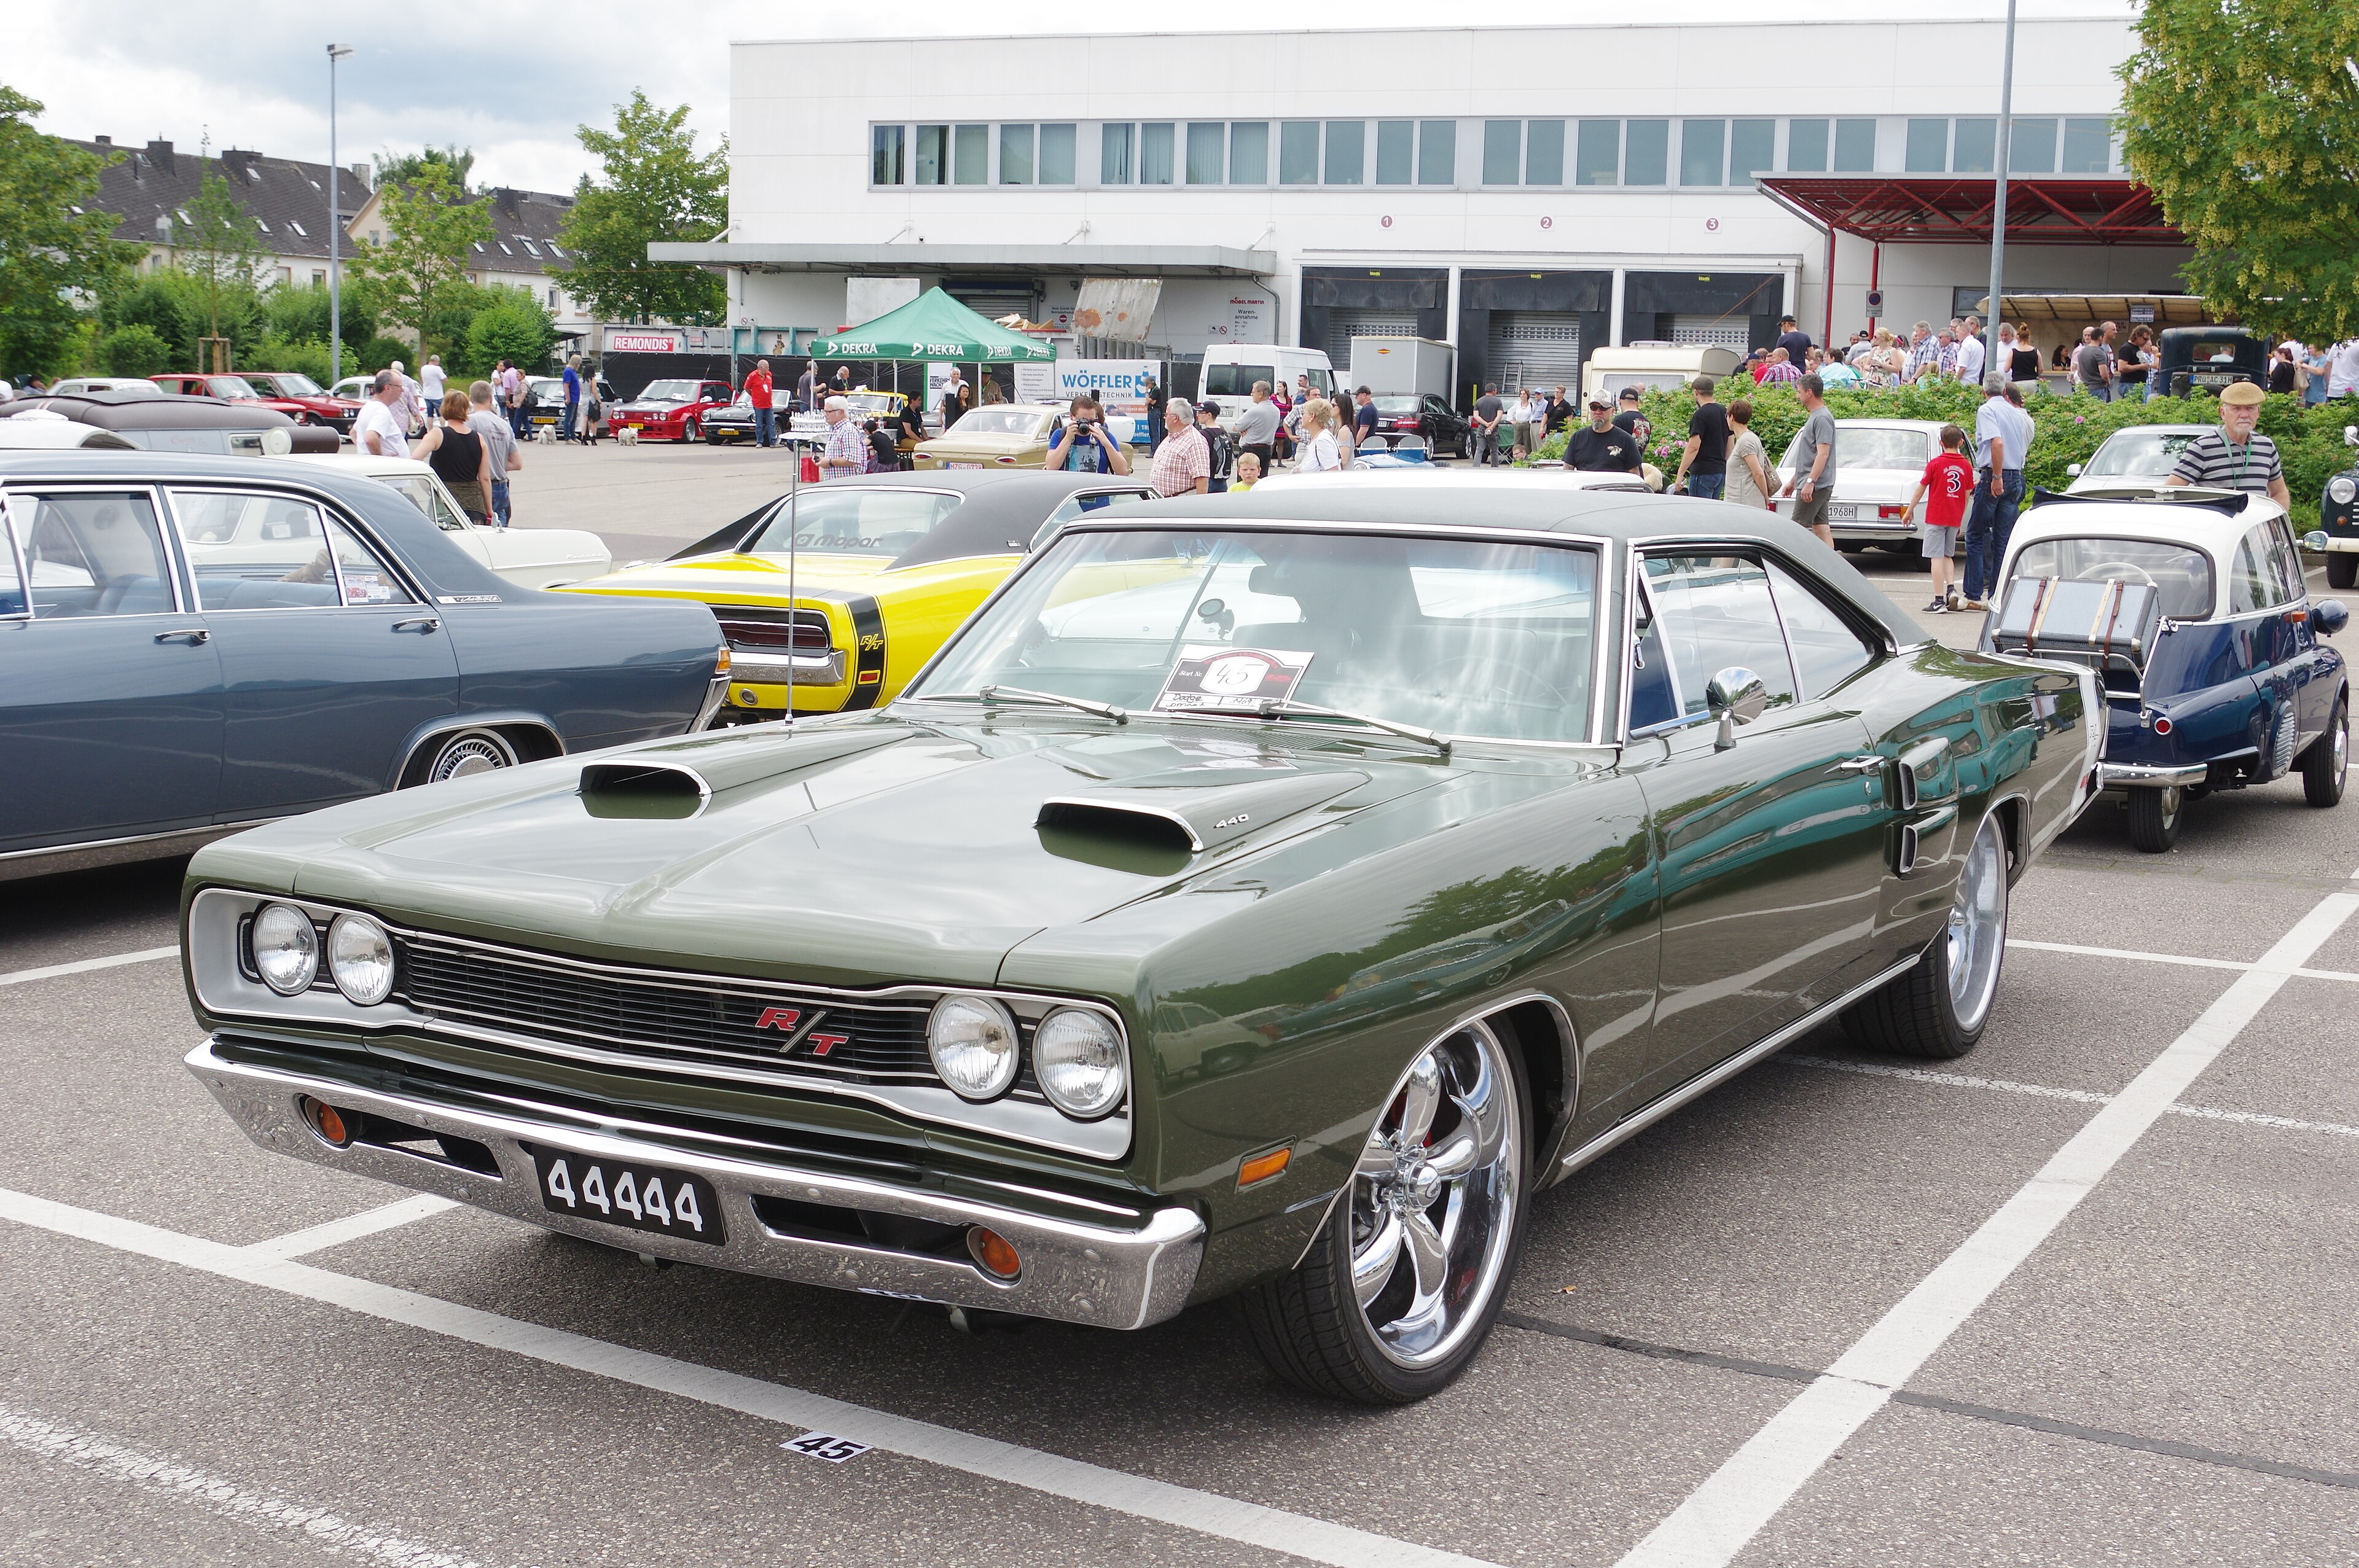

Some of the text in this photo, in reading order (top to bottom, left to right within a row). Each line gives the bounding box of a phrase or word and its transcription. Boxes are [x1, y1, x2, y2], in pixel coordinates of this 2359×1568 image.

[1384, 217, 1389, 226] 1
[1543, 217, 1550, 228] 2
[1709, 219, 1716, 228] 3
[615, 337, 668, 351] REMONDIS
[842, 343, 878, 354] DEKRA
[927, 344, 964, 356] DEKRA
[994, 346, 1012, 357] DEKRA
[1062, 370, 1132, 389] WÖFFLER
[1947, 470, 1961, 493] 3
[1828, 507, 1854, 517] 1968H
[859, 633, 884, 651] R/T
[1216, 663, 1264, 685] 45
[1172, 693, 1203, 703] Dodge
[1215, 813, 1250, 829] 440
[754, 1007, 849, 1056] R/T
[547, 1158, 703, 1233] 44444
[792, 1436, 867, 1460] 45
